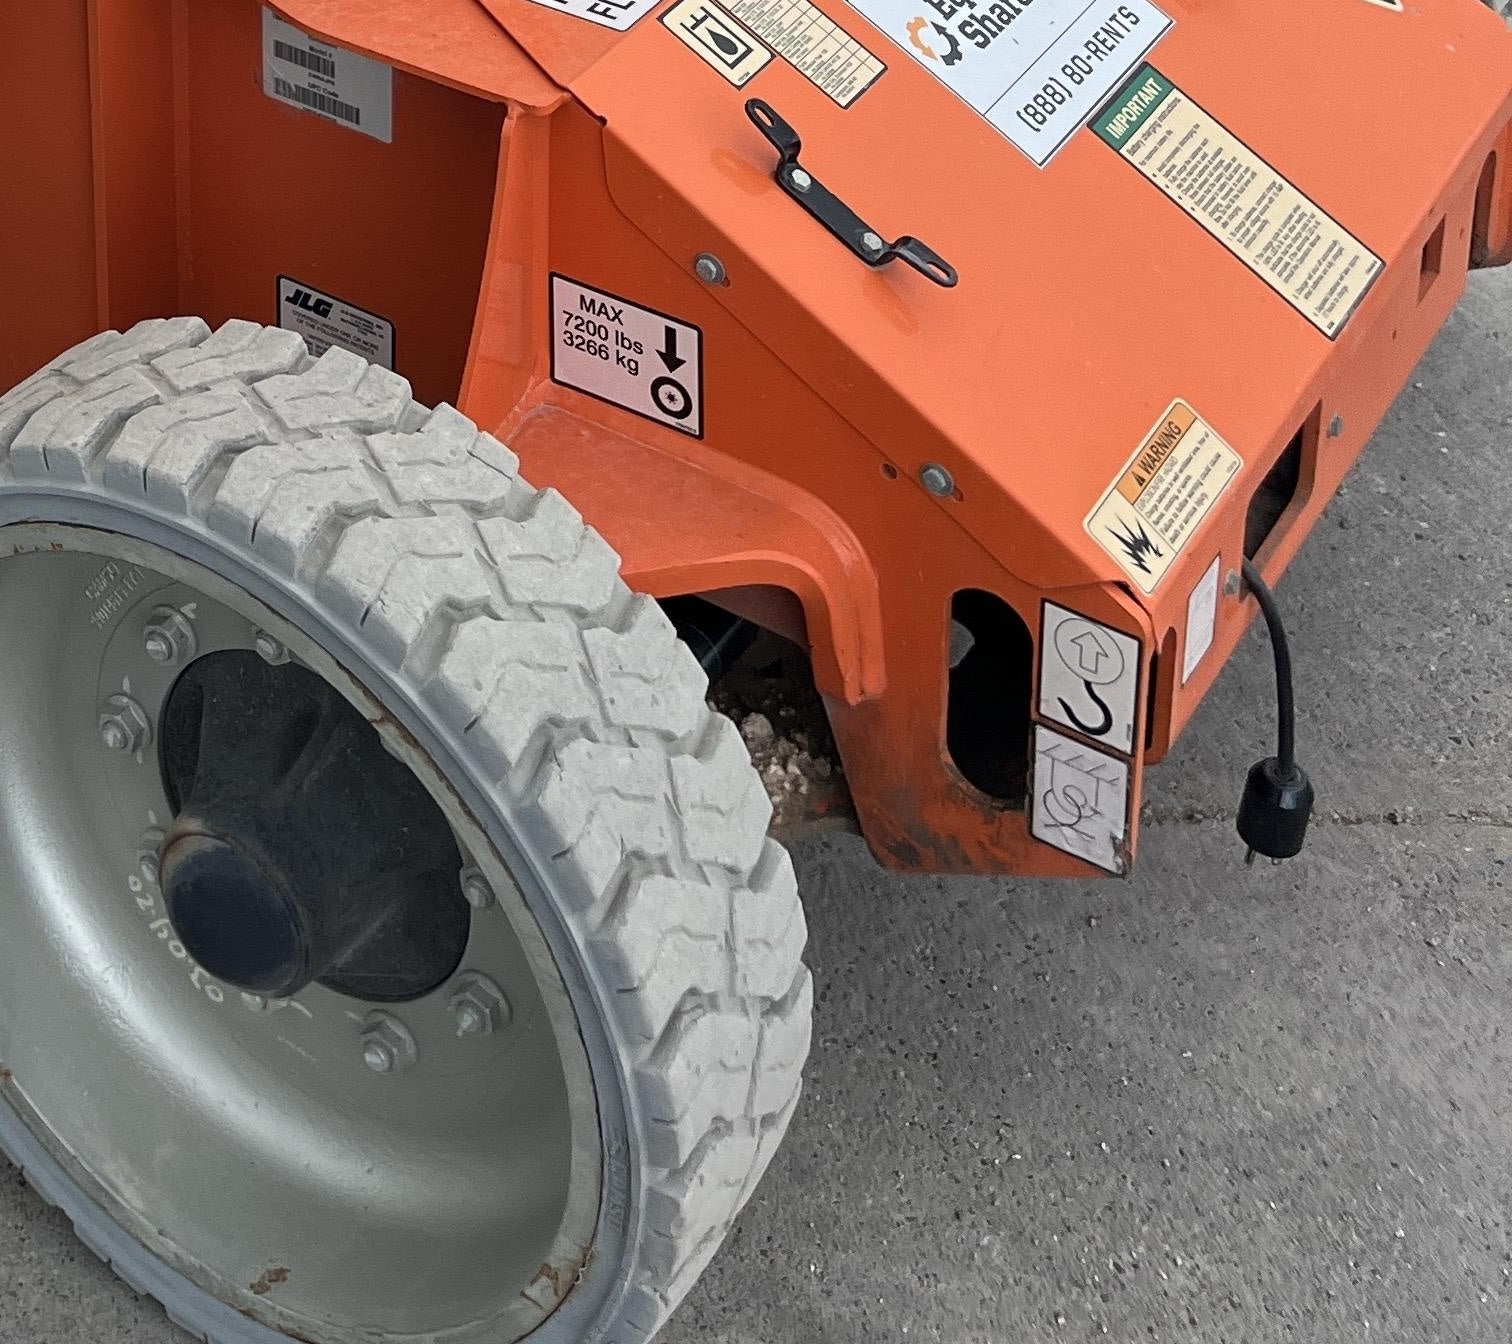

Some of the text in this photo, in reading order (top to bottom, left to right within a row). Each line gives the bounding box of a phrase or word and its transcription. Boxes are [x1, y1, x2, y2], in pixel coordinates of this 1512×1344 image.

[1015, 4, 1142, 134] (888) 80-RENTS
[1105, 77, 1164, 140] IMPORTANT
[284, 288, 334, 319] JLG
[579, 293, 624, 327] MAX
[562, 309, 644, 355] 7200 lbs
[562, 330, 639, 377] 3266 kg
[1138, 421, 1182, 475] WARNING
